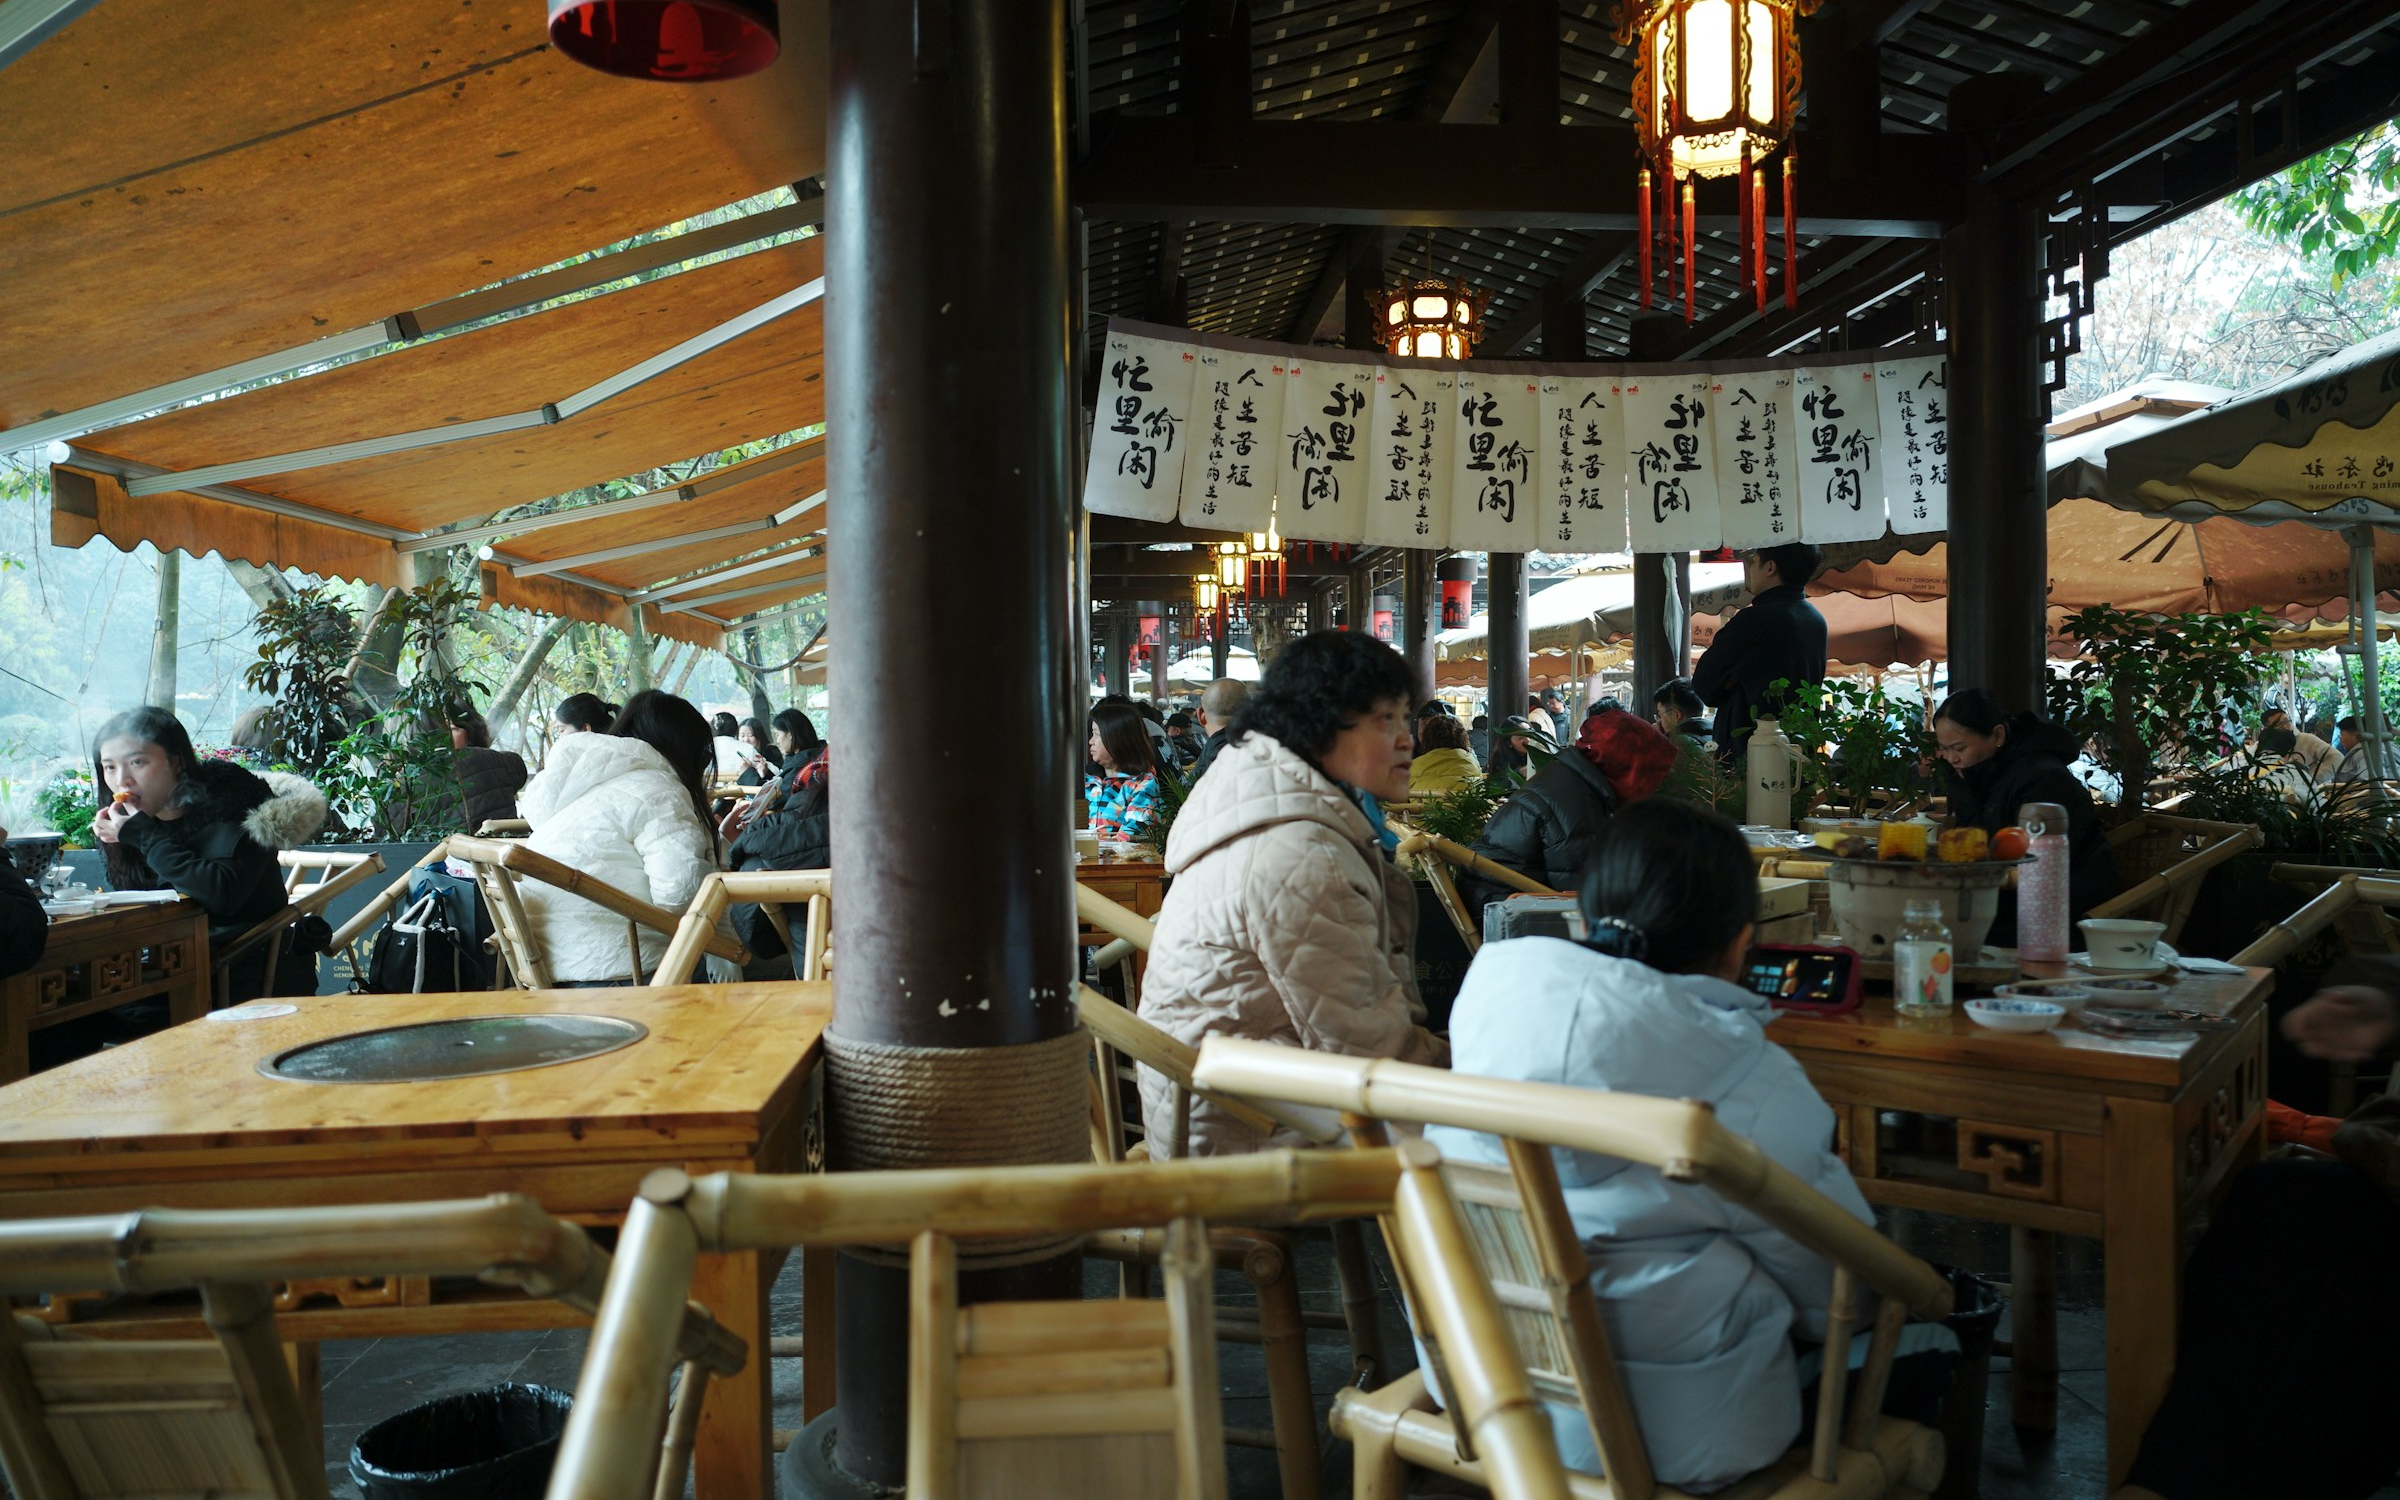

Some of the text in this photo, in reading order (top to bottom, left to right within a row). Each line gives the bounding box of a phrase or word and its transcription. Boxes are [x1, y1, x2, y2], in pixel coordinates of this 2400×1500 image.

[1225, 368, 1263, 487] 人生苦短
[1578, 392, 1605, 510] 人生苦短
